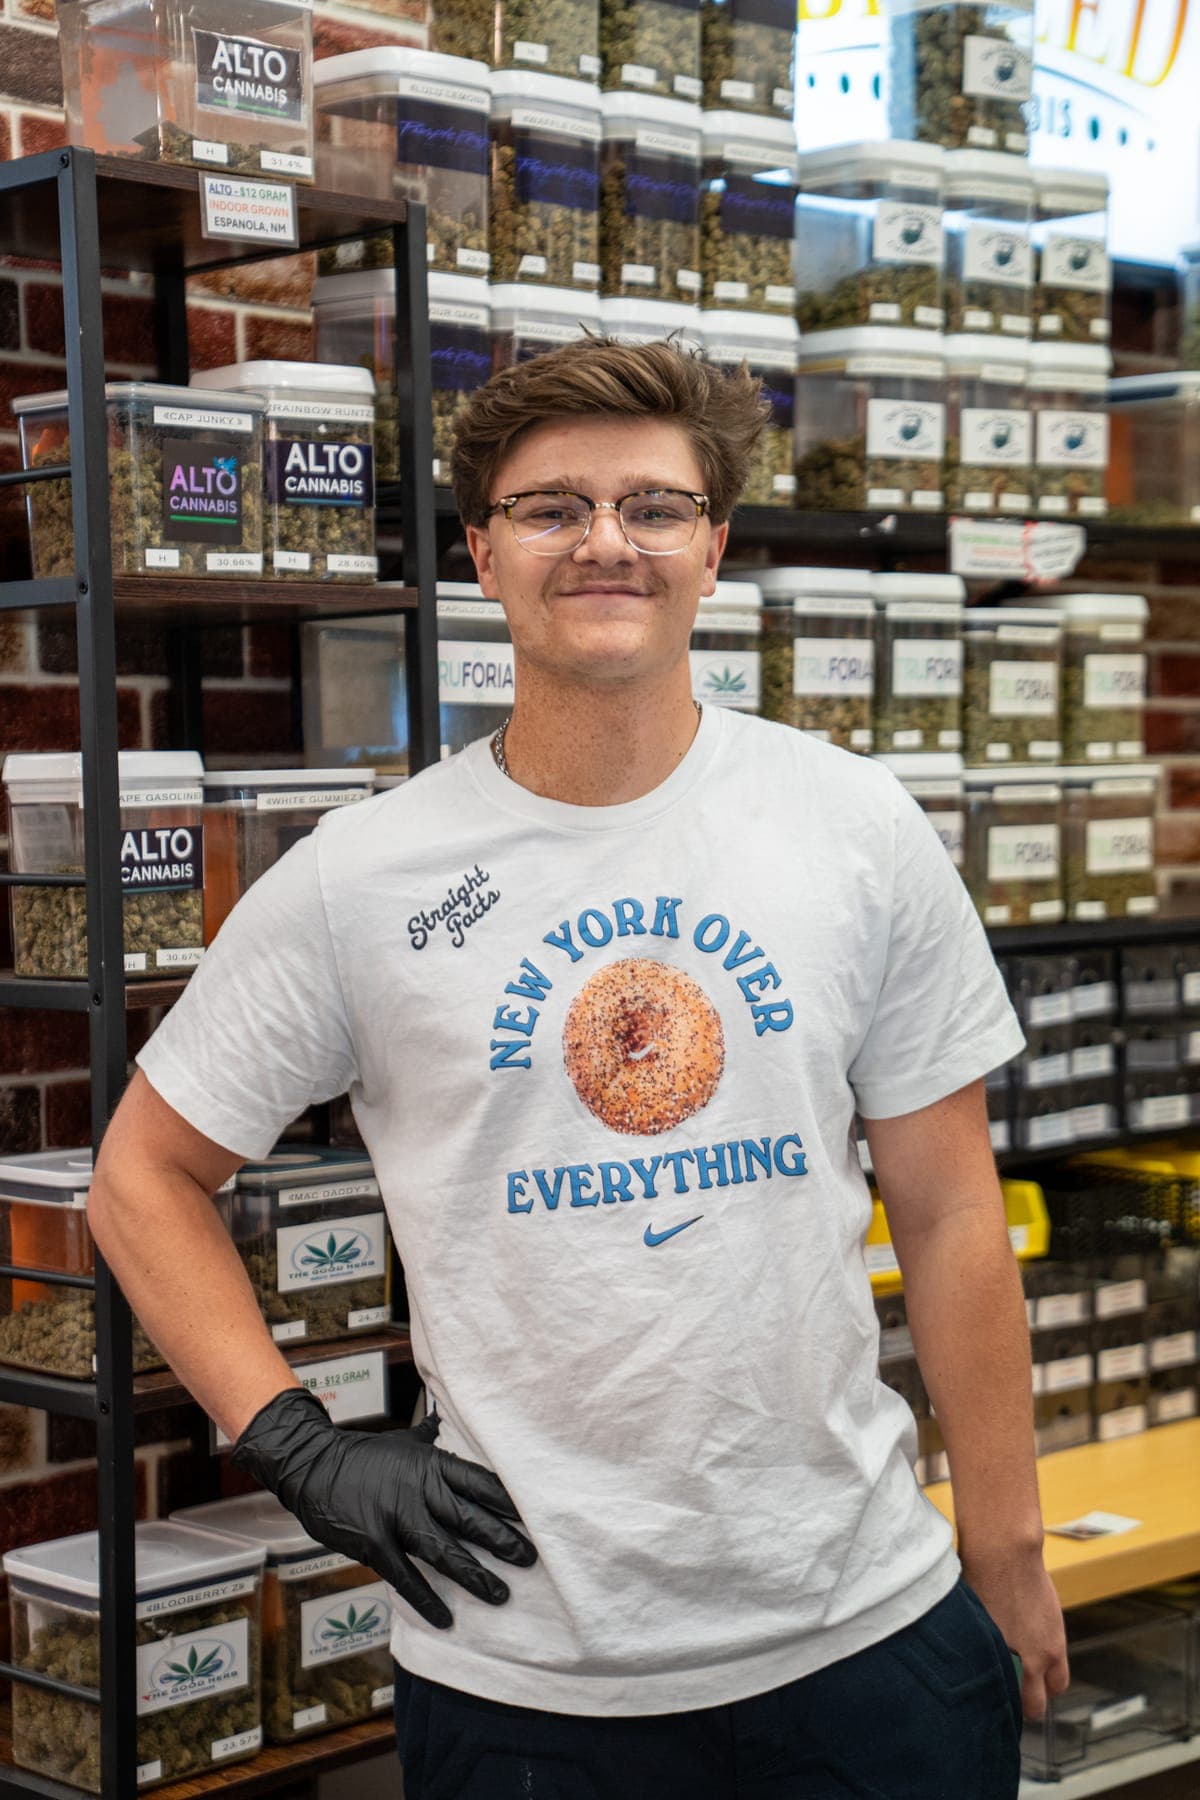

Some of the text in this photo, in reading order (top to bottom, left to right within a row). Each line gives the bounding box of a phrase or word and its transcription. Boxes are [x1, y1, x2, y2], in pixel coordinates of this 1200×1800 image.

[211, 39, 287, 82] ALTO
[212, 76, 288, 104] CANNABIS
[209, 182, 232, 195] ALTO
[240, 187, 256, 198] $12
[259, 189, 287, 202] GRAM
[209, 200, 289, 217] INDOOR GROWN
[270, 223, 286, 233] NM
[284, 442, 363, 475] ALTO
[169, 465, 237, 495] ALTO
[284, 476, 364, 494] CANNABIS
[169, 495, 238, 513] CANNABIS
[288, 556, 296, 564] H
[438, 660, 514, 688] RUFORIA
[119, 794, 141, 803] APE
[121, 828, 194, 862] ALTO
[121, 863, 193, 883] CANNABIS
[407, 864, 490, 950] Straight
[446, 890, 501, 948] Facts
[490, 896, 794, 1070] NEW YORK OVER
[507, 1132, 808, 1214] EVERYTHING
[288, 1271, 309, 1279] THE
[312, 1266, 344, 1275] GOOD
[346, 1260, 375, 1270] HERB
[324, 1374, 340, 1387] $12
[342, 1368, 370, 1382] GRAM
[171, 1680, 205, 1694] GOOD
[208, 1671, 238, 1683] HERB
